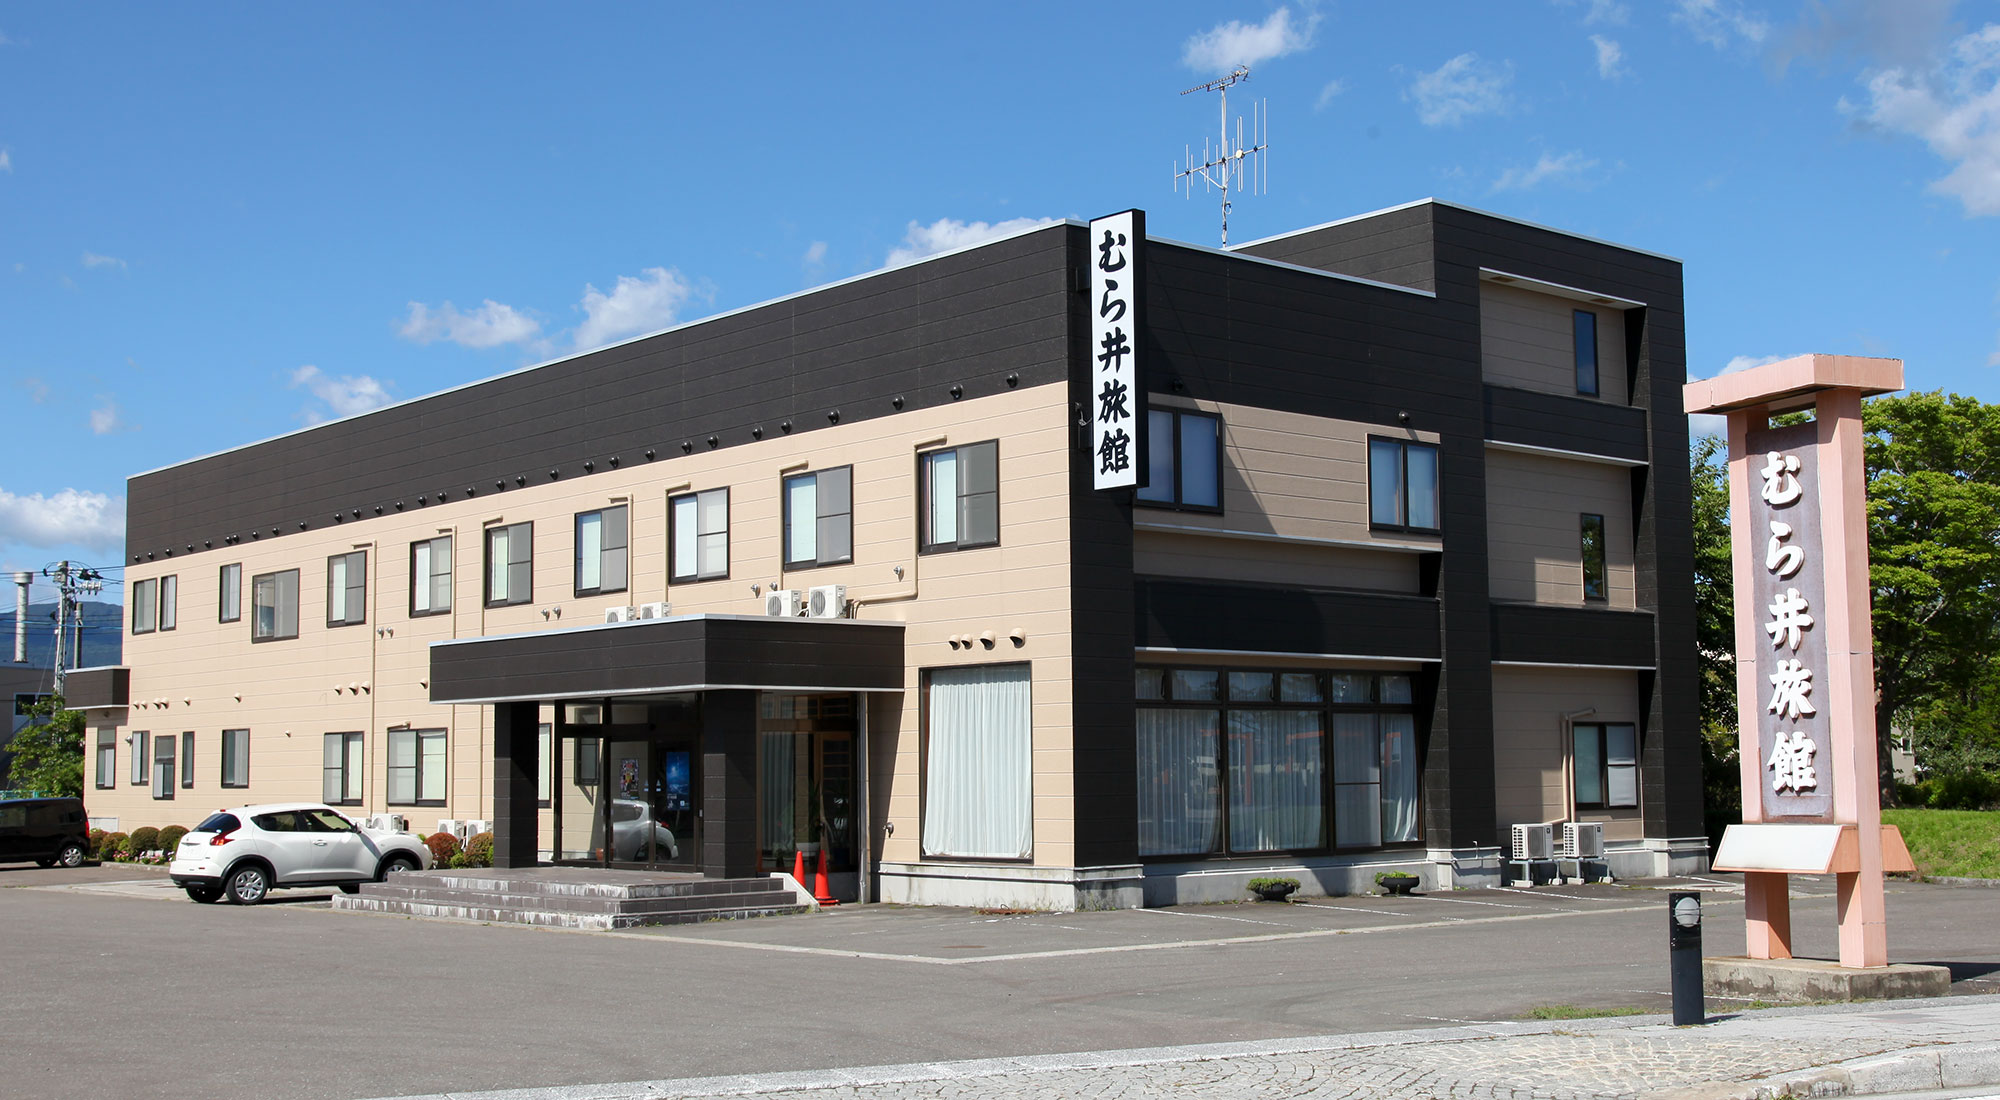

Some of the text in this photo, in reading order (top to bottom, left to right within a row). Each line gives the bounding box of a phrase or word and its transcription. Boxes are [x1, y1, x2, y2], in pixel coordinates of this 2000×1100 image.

[1097, 229, 1131, 475] むら井旅館
[1759, 451, 1817, 793] むら井旅館
